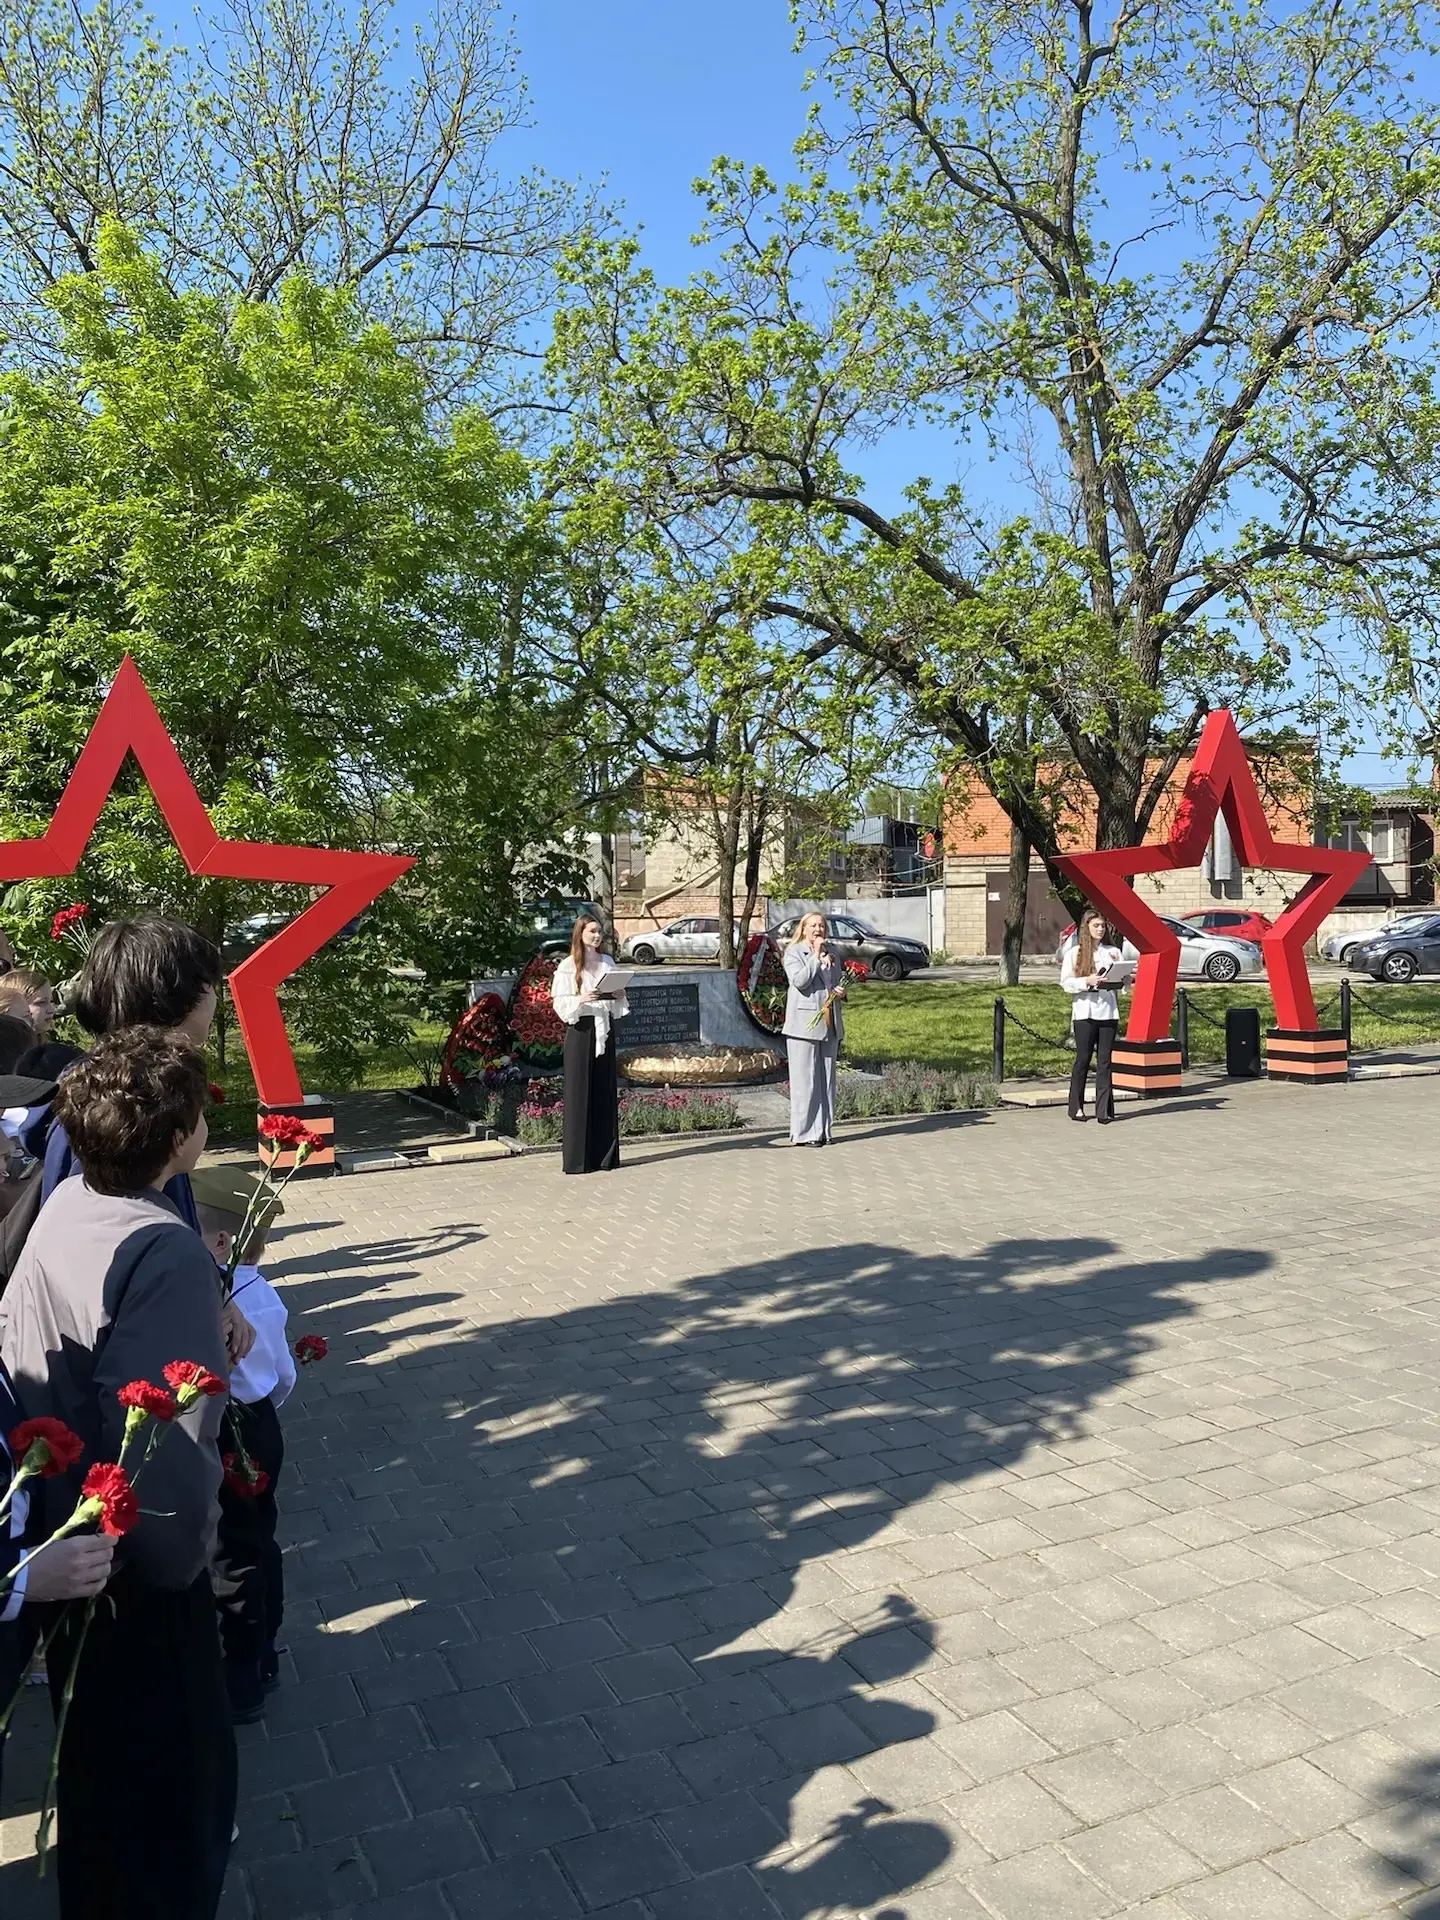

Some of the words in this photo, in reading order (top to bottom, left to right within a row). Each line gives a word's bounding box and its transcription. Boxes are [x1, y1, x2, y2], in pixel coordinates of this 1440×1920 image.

[641, 997, 668, 1007] СОВЕТСКИХ
[670, 996, 690, 1005] ВОИНОВ
[668, 1005, 697, 1014] ФАШИСТАМИ
